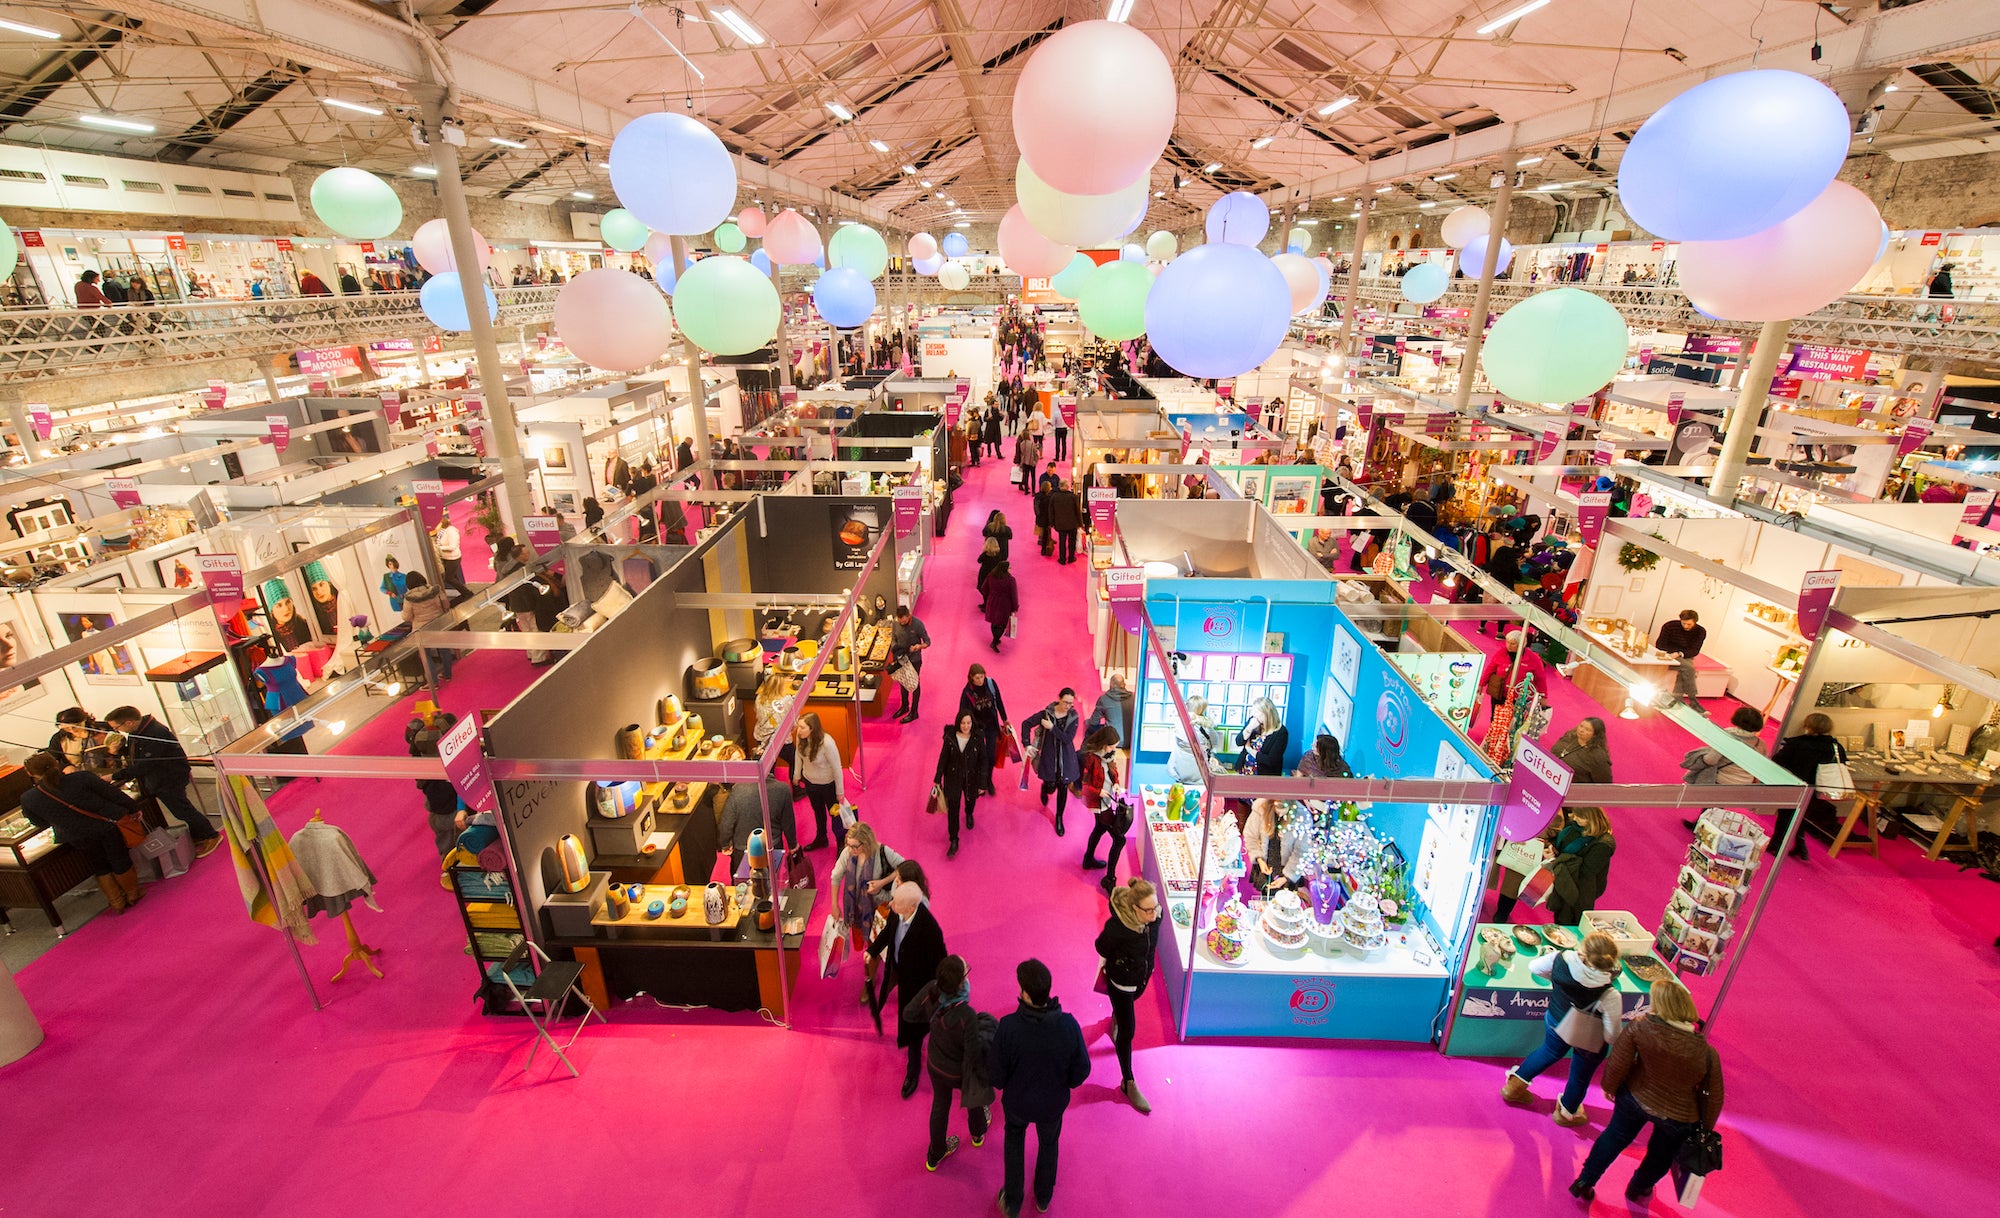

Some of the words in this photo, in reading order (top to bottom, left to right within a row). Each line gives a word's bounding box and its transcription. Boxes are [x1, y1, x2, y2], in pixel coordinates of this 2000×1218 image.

[1028, 278, 1052, 290] IRELA
[316, 350, 341, 361] FOOD
[1810, 351, 1829, 359] THIS
[1830, 353, 1852, 363] WAY
[311, 358, 355, 372] MPORIUM
[1799, 360, 1854, 373] RESTAURANT
[1812, 371, 1831, 380] ATM
[416, 483, 441, 491] Gifted
[1968, 495, 1991, 503] Gifted
[527, 520, 555, 528] Gifted
[202, 559, 236, 568] Gifted
[1111, 572, 1141, 581] Gifted
[1807, 575, 1837, 585] Gifted
[444, 722, 473, 756] Gifted
[1523, 748, 1562, 786] Gifted
[1521, 788, 1542, 808] BUTTON
[1522, 797, 1541, 815] STUDIO
[1510, 842, 1536, 861] Gifted
[1291, 976, 1336, 990] Button
[1293, 1016, 1329, 1026] Studio
